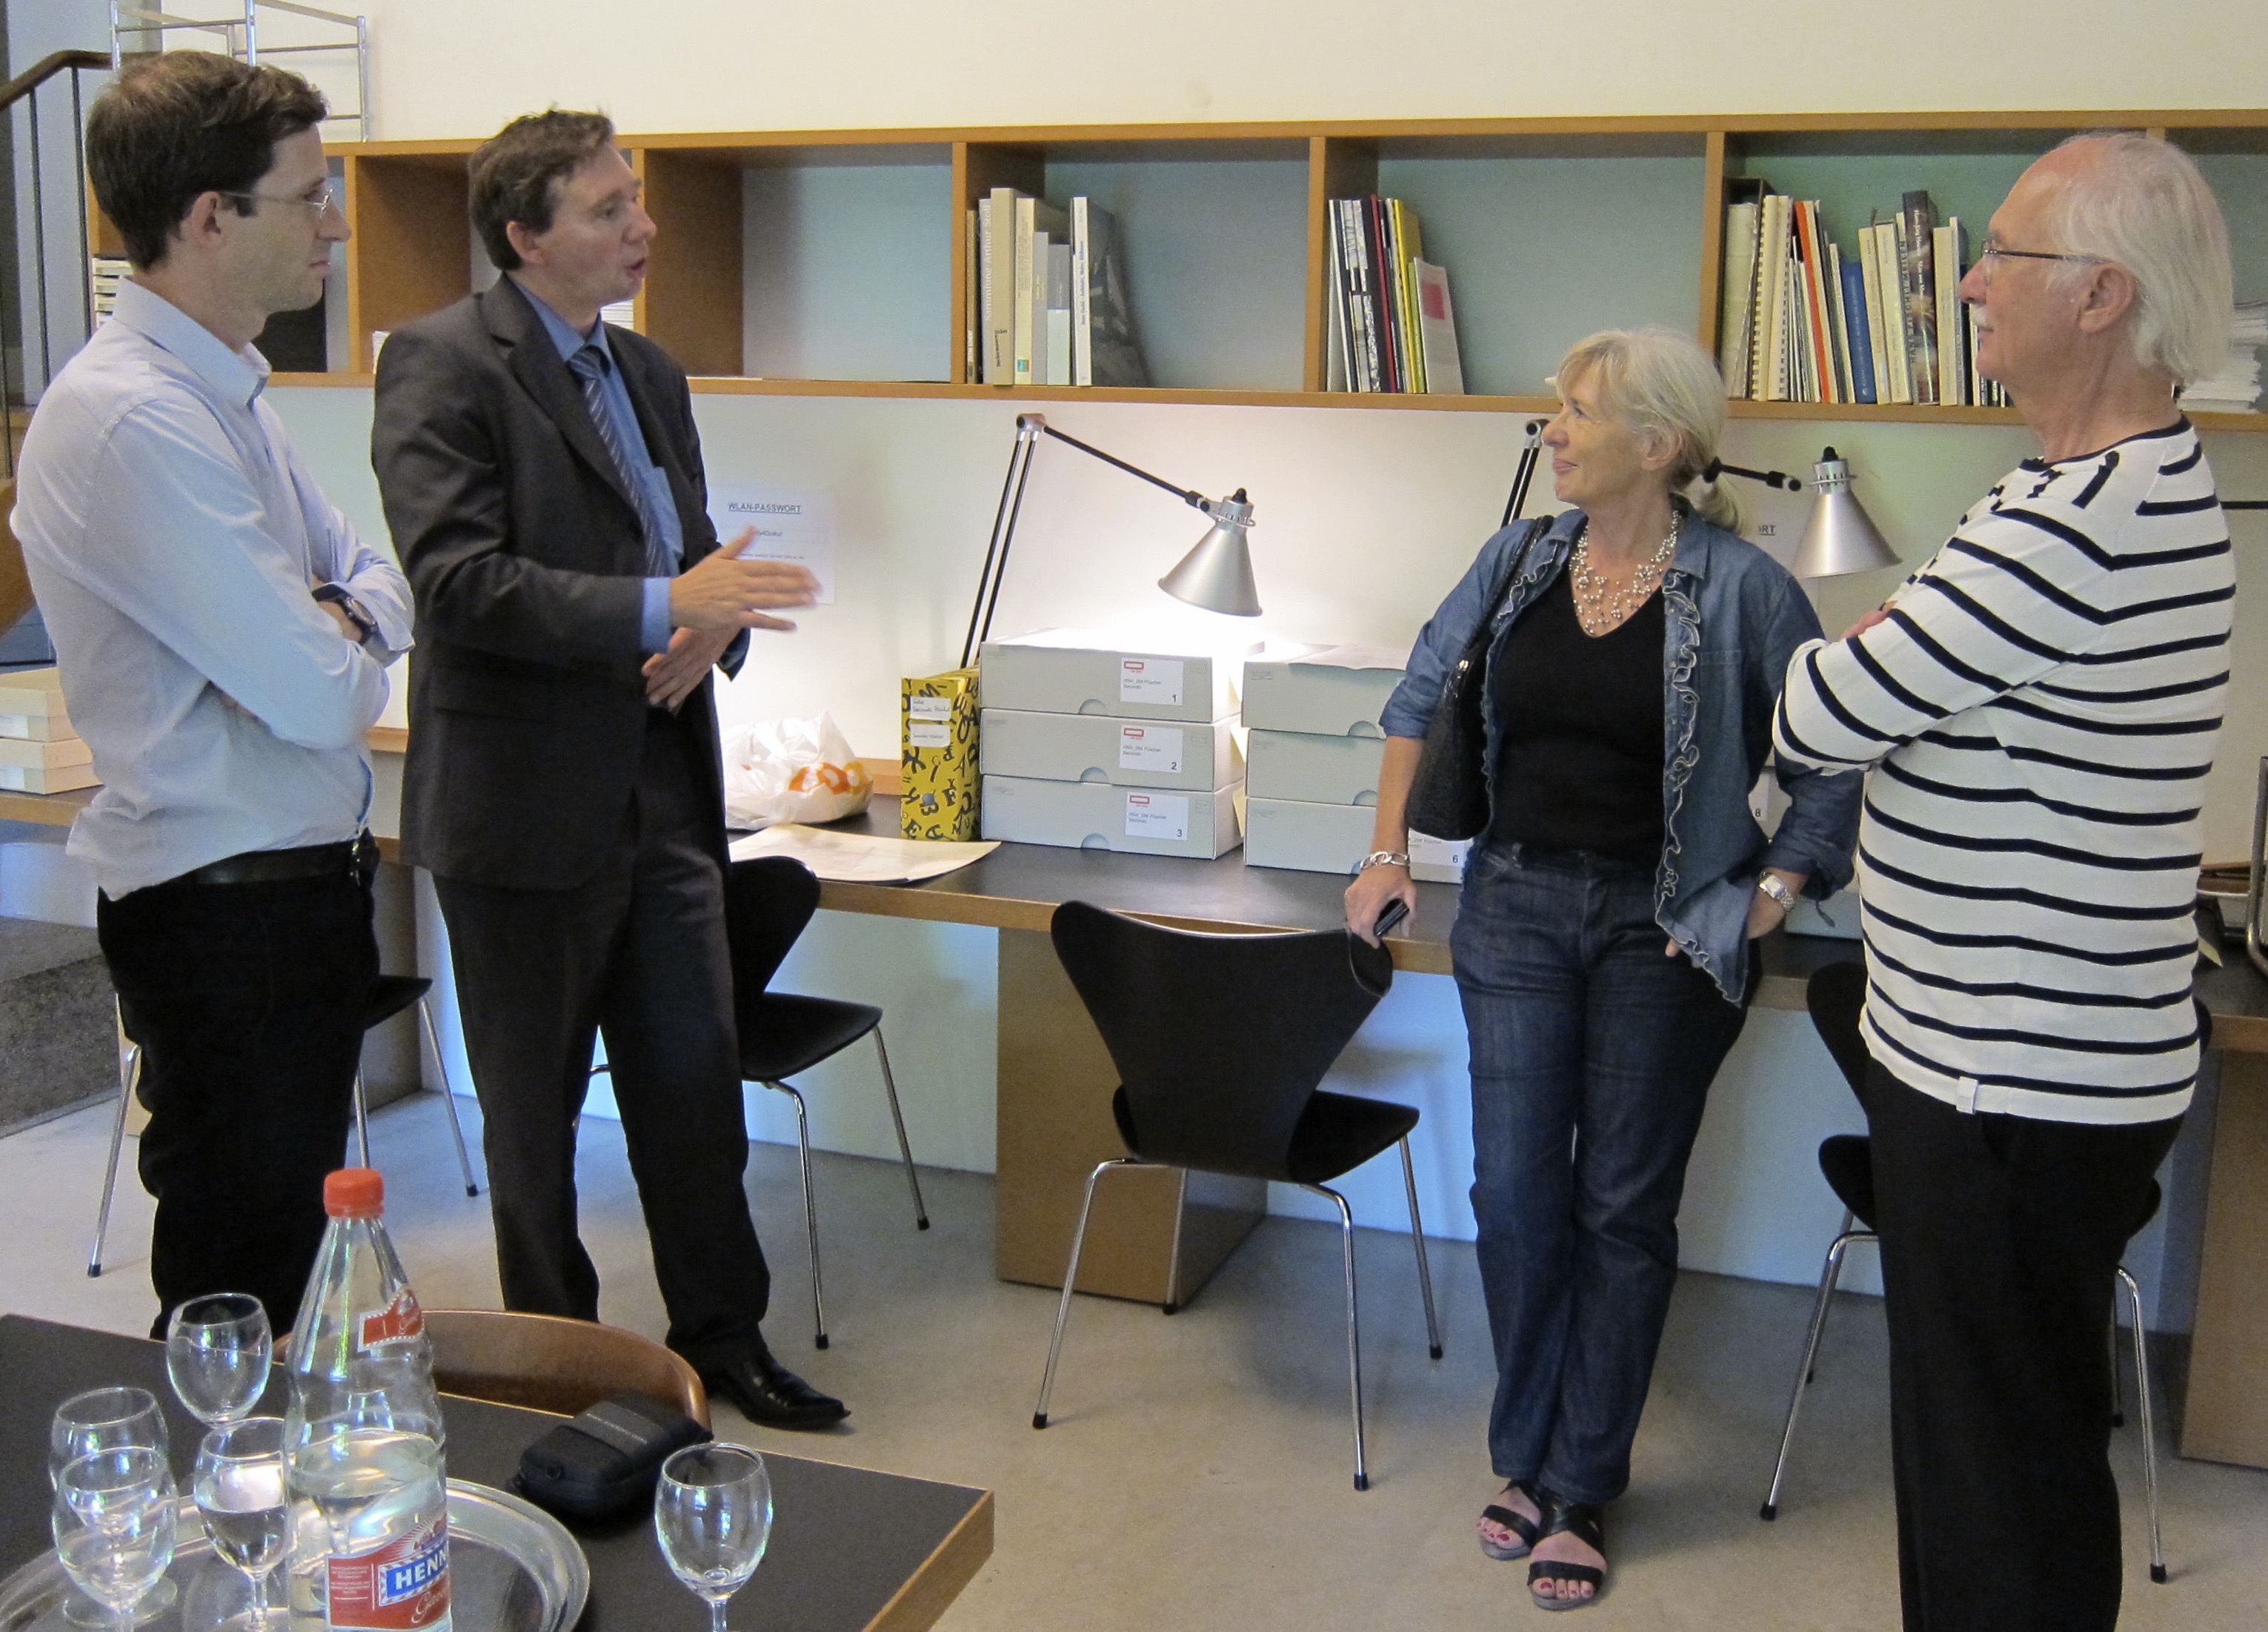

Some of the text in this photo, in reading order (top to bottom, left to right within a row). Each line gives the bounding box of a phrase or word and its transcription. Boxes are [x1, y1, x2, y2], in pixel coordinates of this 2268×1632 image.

[728, 503, 801, 514] WLAN-PASSWORT
[1172, 694, 1177, 703] 1
[1171, 762, 1177, 771] 2
[1755, 809, 1760, 817] 8
[1177, 829, 1183, 838] 3
[1452, 855, 1458, 863] 6
